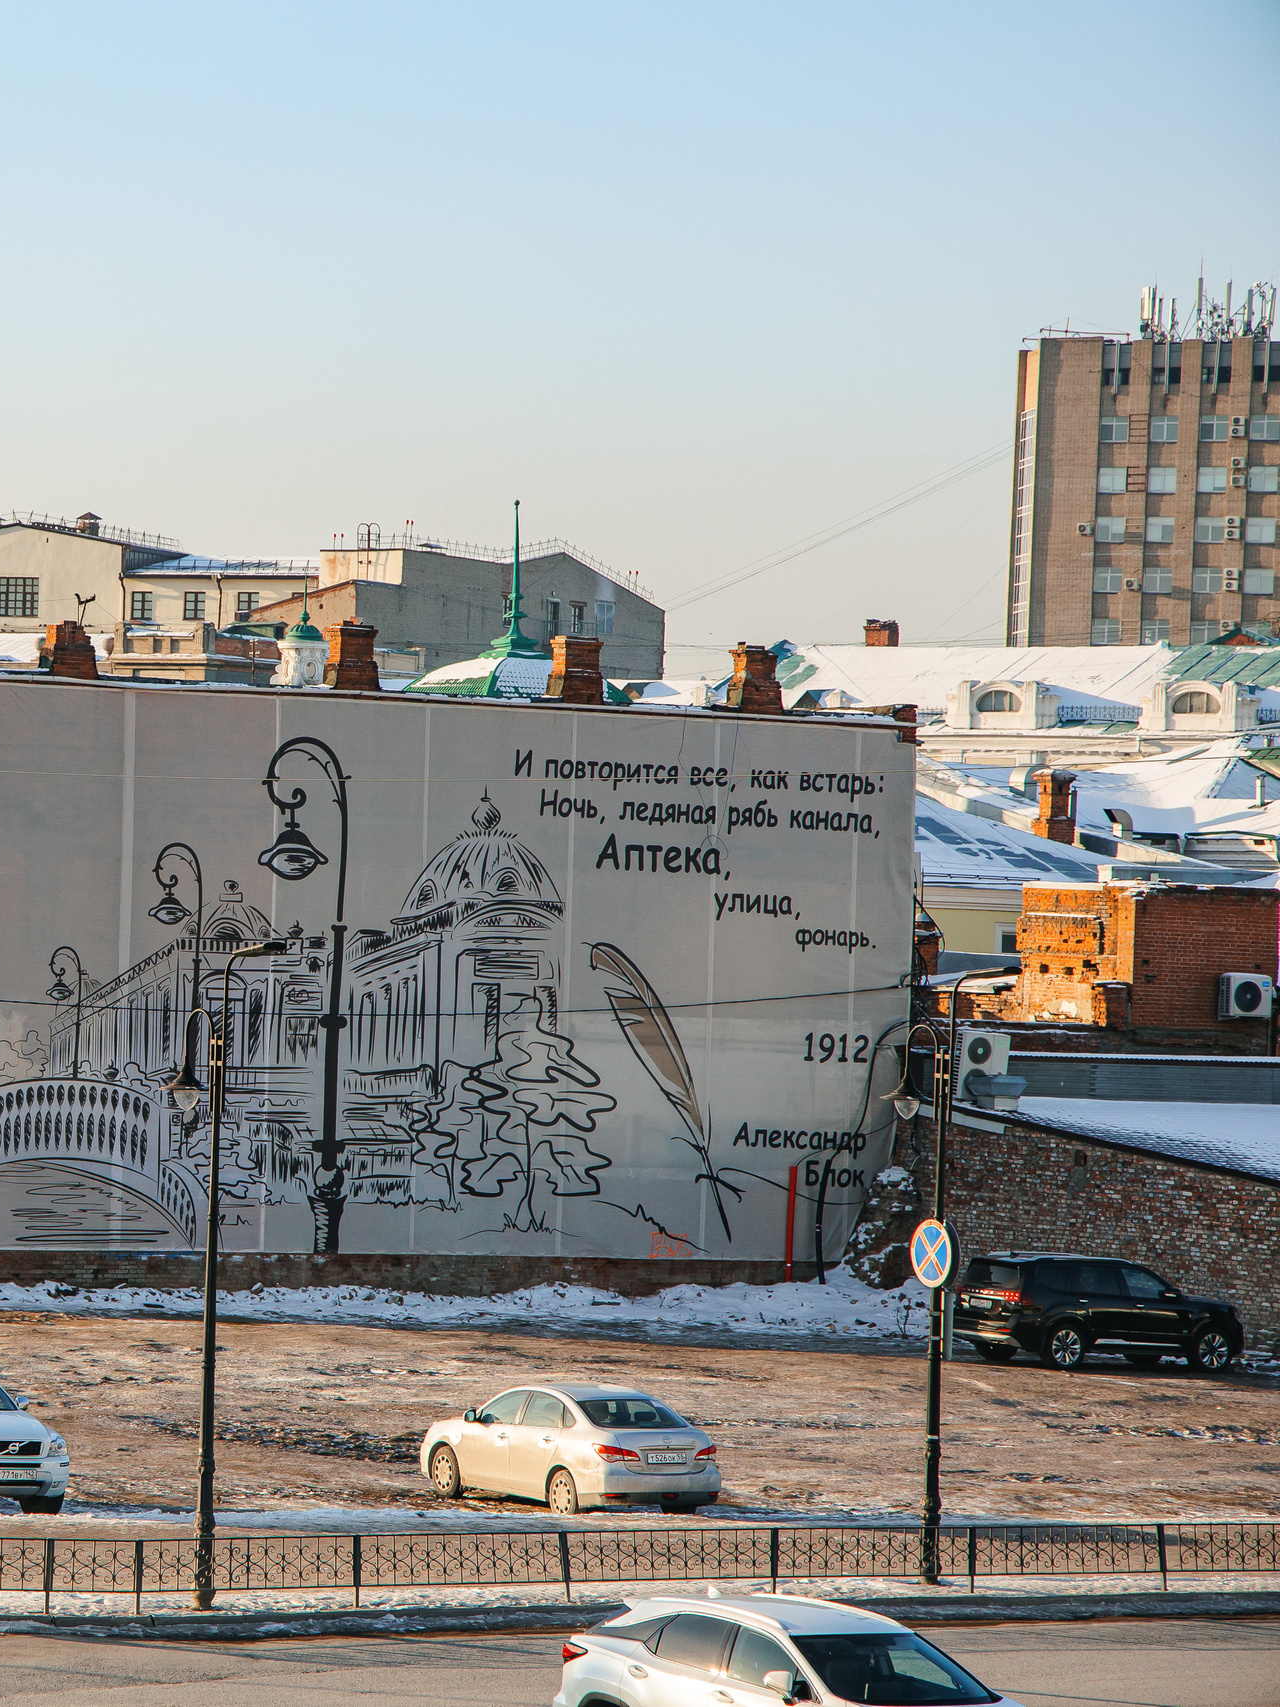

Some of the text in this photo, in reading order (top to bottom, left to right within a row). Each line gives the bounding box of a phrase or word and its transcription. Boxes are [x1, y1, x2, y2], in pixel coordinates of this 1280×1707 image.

[514, 748, 885, 802] И повторится все, как встарь:
[539, 788, 880, 839] Ночь, ледяная рябь канала,
[595, 832, 732, 881] Аптека,
[714, 892, 801, 921] улица,
[795, 928, 877, 954] фонарь.
[803, 1032, 869, 1063] 1912
[732, 1121, 867, 1160] Александр
